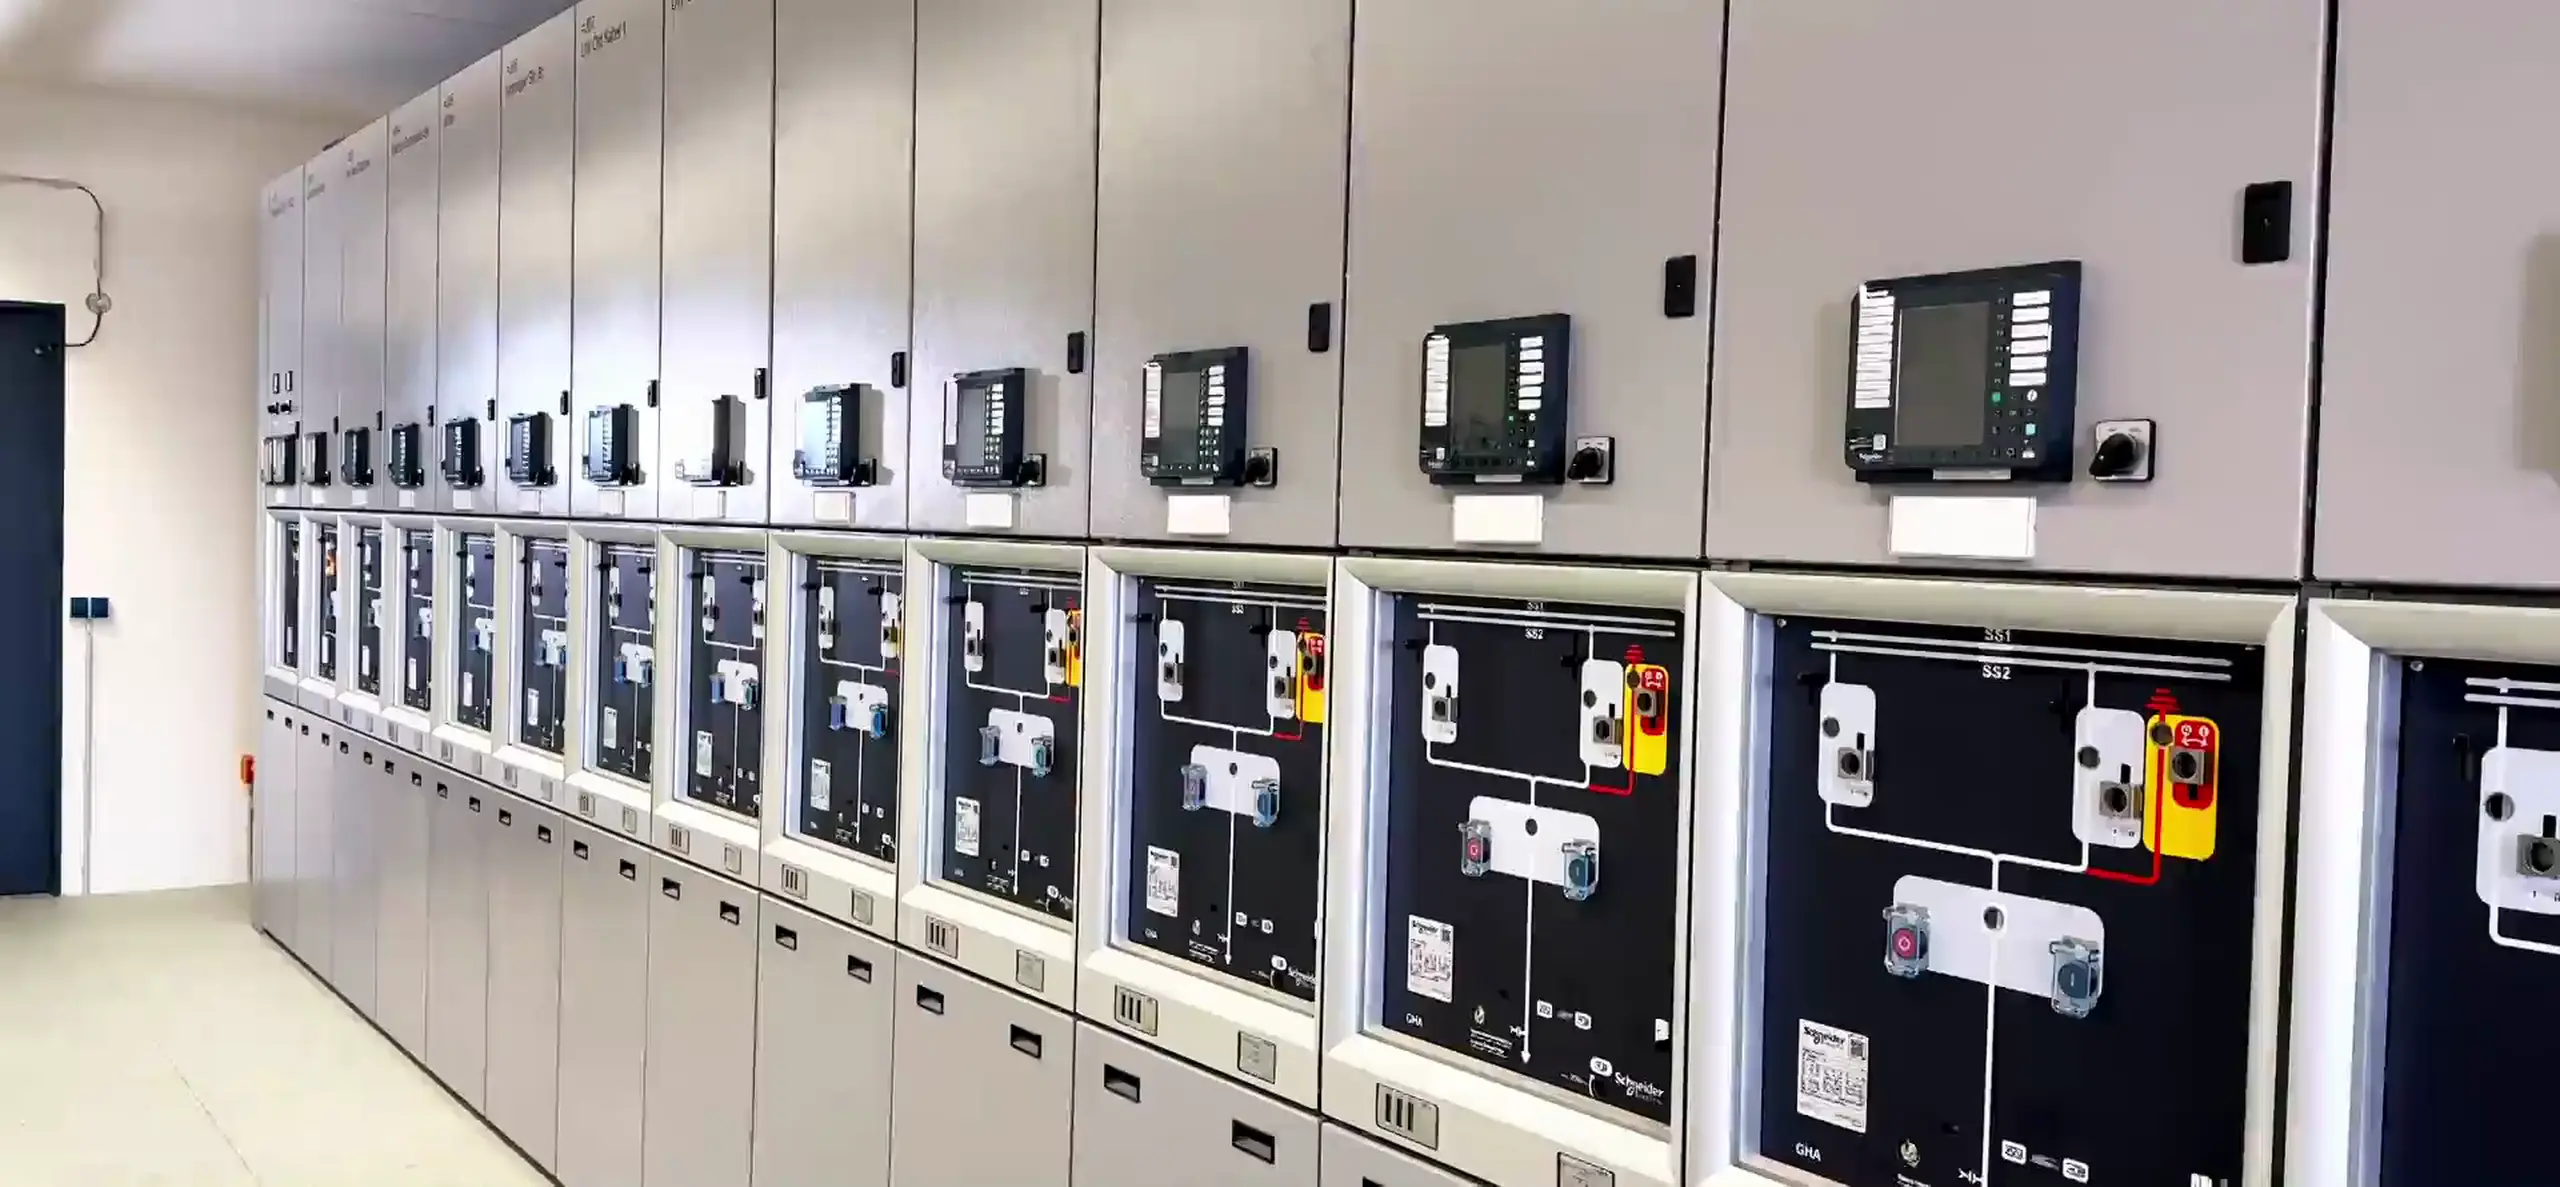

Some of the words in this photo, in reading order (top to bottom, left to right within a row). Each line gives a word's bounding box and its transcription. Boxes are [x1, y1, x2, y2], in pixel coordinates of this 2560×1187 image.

[1982, 664, 2011, 680] SS2
[1614, 1072, 1664, 1097] Schneider
[1795, 1142, 1821, 1162] GHA
